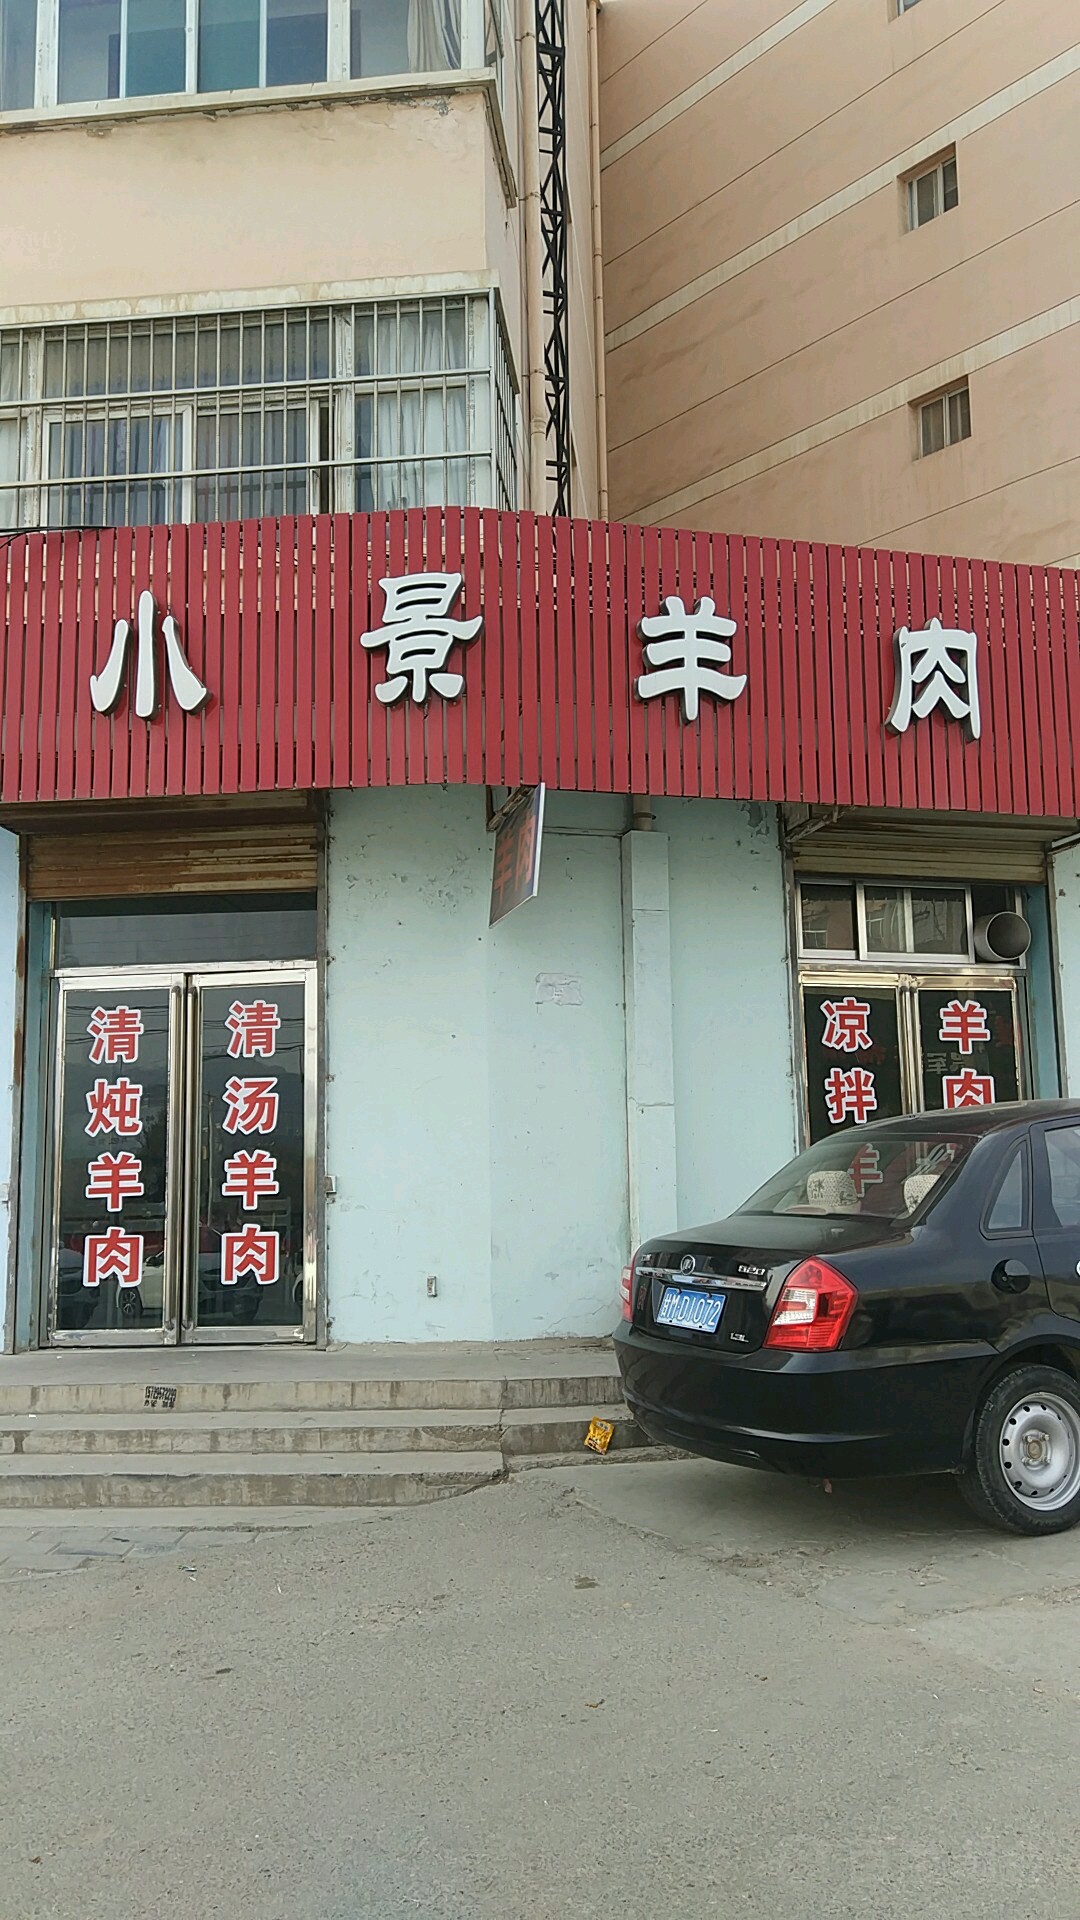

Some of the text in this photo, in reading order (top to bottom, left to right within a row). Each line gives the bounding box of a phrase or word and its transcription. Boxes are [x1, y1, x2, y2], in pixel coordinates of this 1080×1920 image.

[89, 571, 982, 741] 小景羊肉
[493, 810, 537, 906] 羊肉
[82, 1004, 145, 1288] 清炖羊肉
[220, 999, 282, 1287] 清汤羊肉
